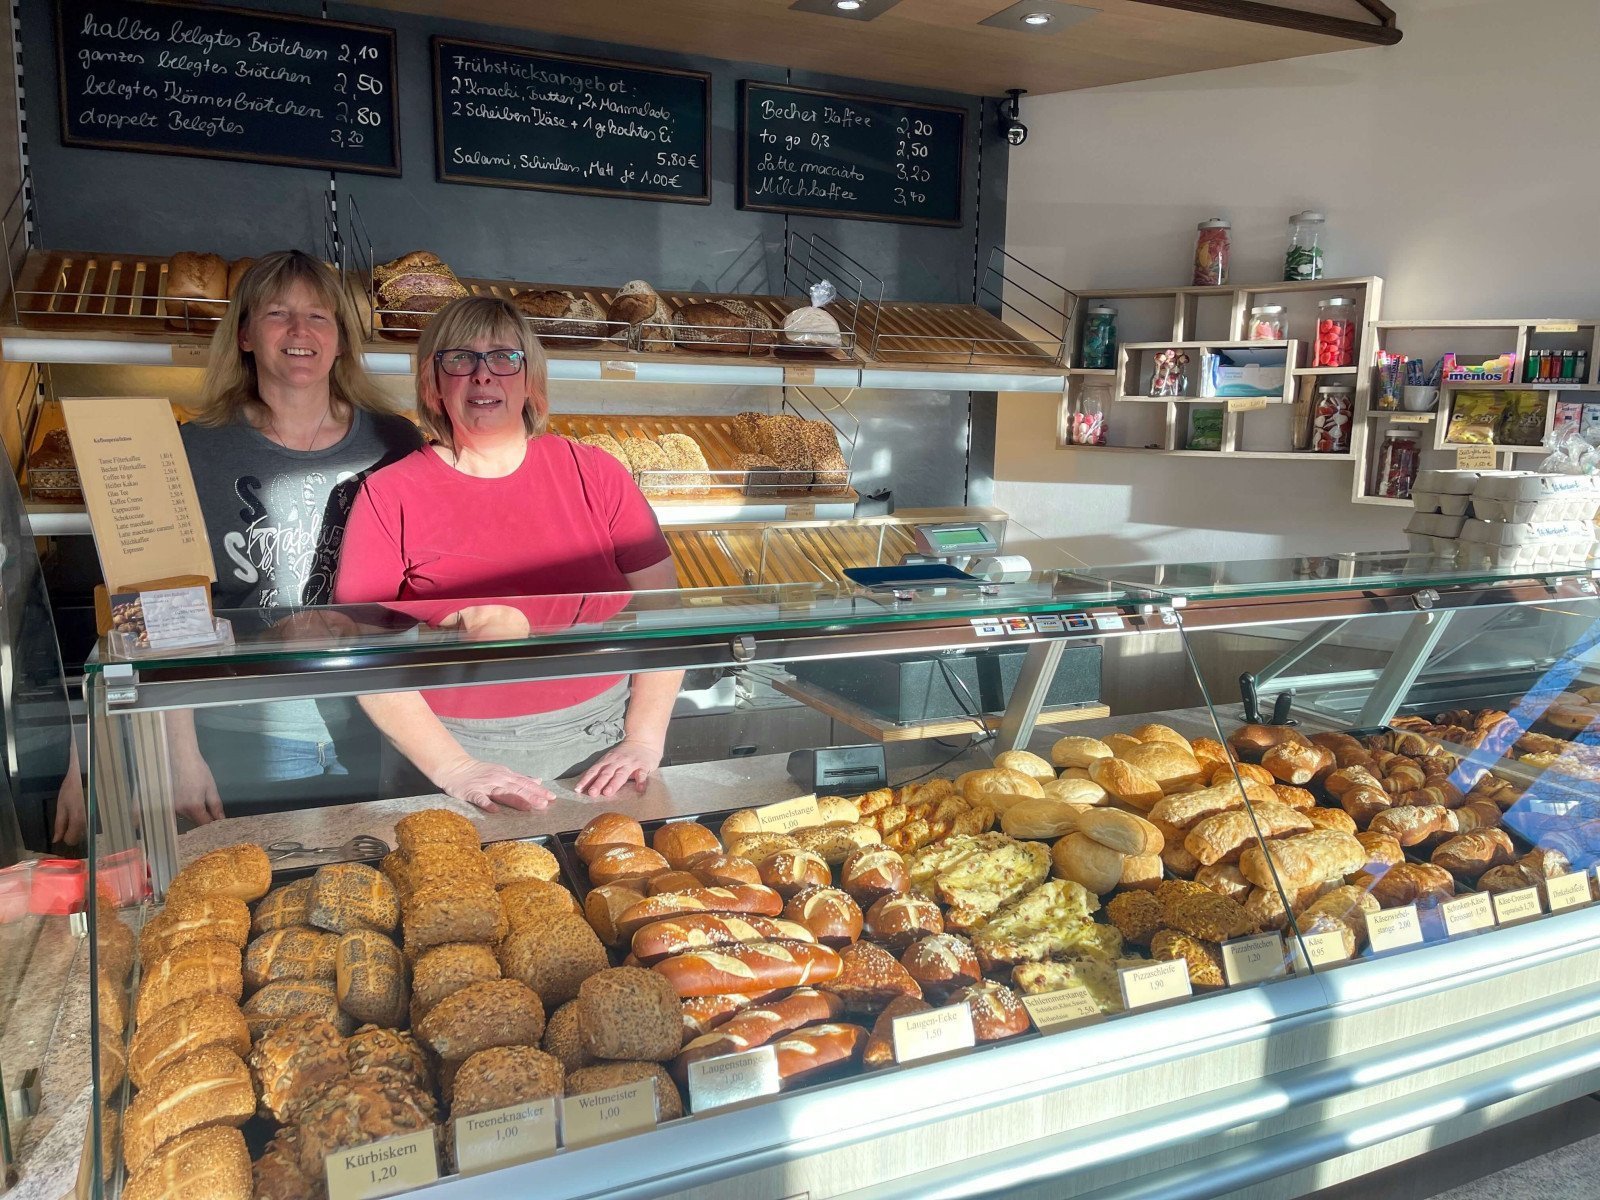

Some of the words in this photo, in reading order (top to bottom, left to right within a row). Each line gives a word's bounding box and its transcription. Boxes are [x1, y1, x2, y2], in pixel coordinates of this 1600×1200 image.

[80, 13, 160, 41] halbes
[167, 20, 241, 54] belegtes
[248, 32, 327, 60] Brötchen
[338, 44, 378, 64] 2,10
[78, 49, 145, 69] ganzes
[158, 51, 227, 77] belegtes
[235, 60, 311, 85] Brötchen
[334, 73, 383, 100] 2,50
[451, 76, 461, 94] 2
[82, 75, 157, 100] belegtes
[164, 81, 324, 119] Körnerbrötchen
[336, 102, 381, 126] 2,80
[79, 108, 158, 129] doppelt
[168, 110, 244, 137] Belegtes
[331, 129, 364, 147] 3,20
[452, 102, 462, 115] 2
[466, 102, 530, 123] Scheiben
[531, 107, 568, 127] Käse
[583, 117, 592, 129] 1
[659, 126, 671, 143] Ei
[761, 100, 816, 122] Becher
[824, 106, 871, 128] Kaffee
[896, 117, 932, 139] 2,20
[759, 128, 776, 143] to
[785, 136, 800, 150] go
[810, 132, 830, 149] 0,3
[896, 141, 928, 160] 2,50
[620, 163, 635, 183] je
[896, 163, 931, 182] 3,20
[755, 175, 858, 200] Milchkaffee
[894, 187, 926, 206] 3,40
[1448, 371, 1502, 381] mentos
[119, 463, 147, 471] Filterkaffee
[783, 819, 799, 830] 1,00
[1308, 937, 1323, 946] Käse
[1133, 966, 1176, 982] Pizzaschleife
[1150, 980, 1164, 991] 1,90
[1025, 990, 1088, 1008] Schlemmerstange
[1078, 1006, 1095, 1016] 2,50
[906, 1011, 958, 1031] Laugen-Ecke
[925, 1028, 942, 1040] 1,50
[702, 1055, 763, 1075] Laugenstange
[724, 1072, 744, 1085] 1,00
[578, 1089, 637, 1109] Weltmeister
[466, 1107, 544, 1131] Treeneknacker
[600, 1106, 620, 1120] 1,00
[496, 1126, 518, 1141] 1,00
[345, 1143, 418, 1170] Kürbiskern
[370, 1165, 397, 1184] 1,20
